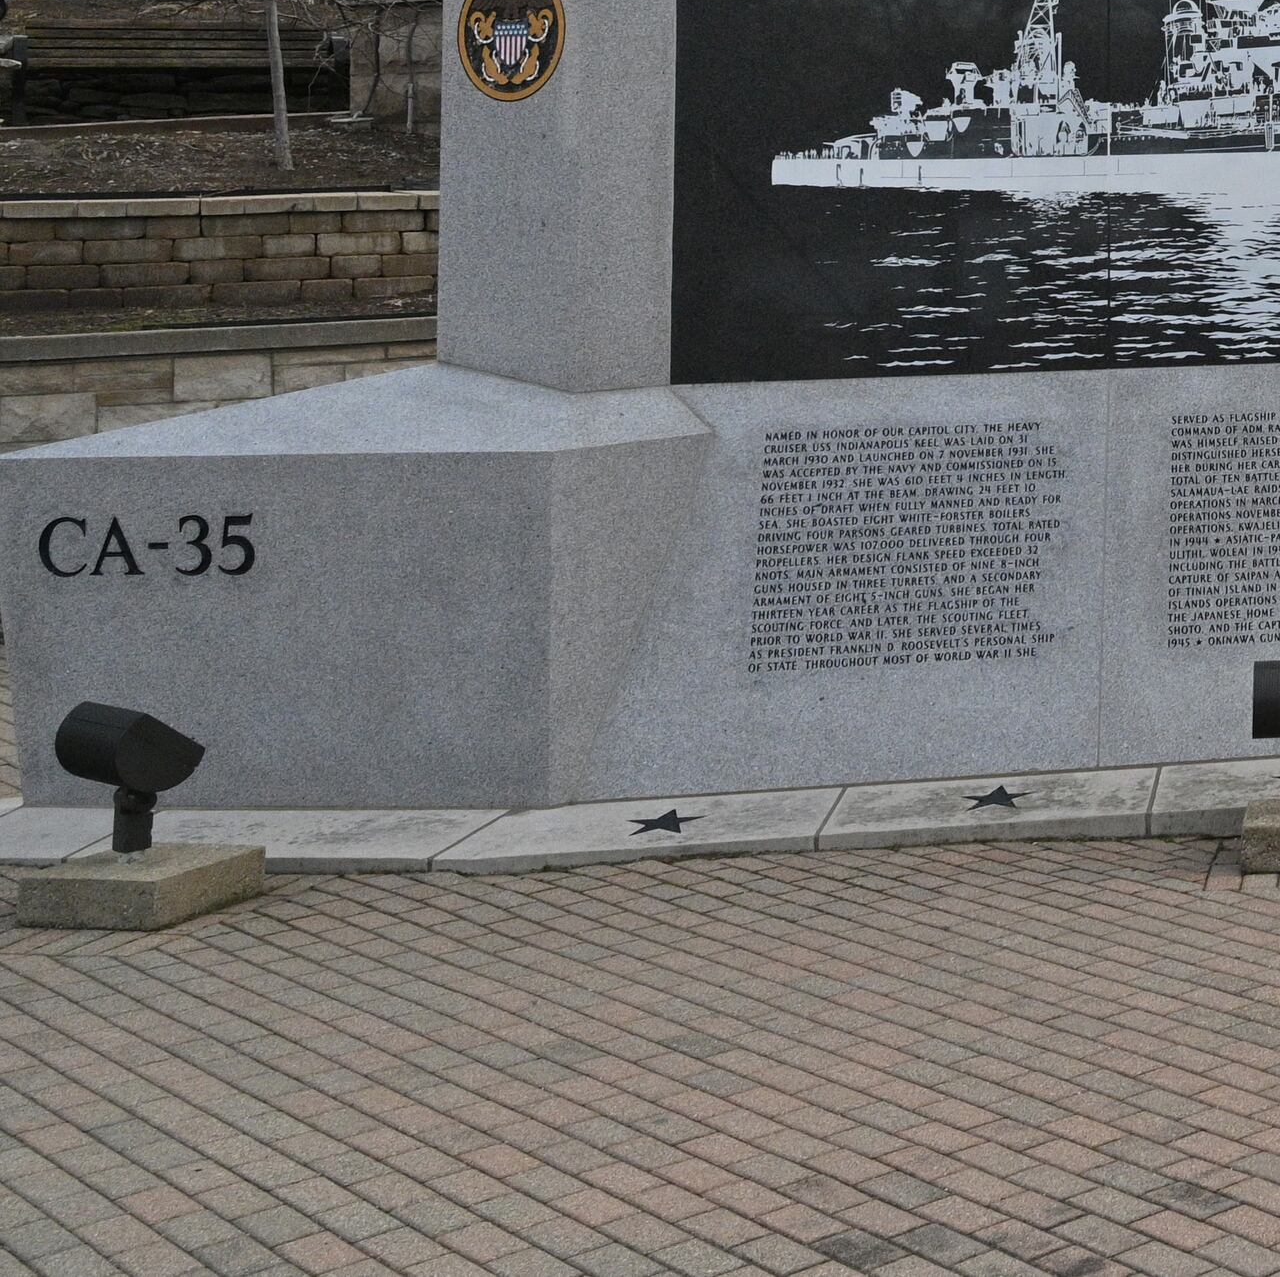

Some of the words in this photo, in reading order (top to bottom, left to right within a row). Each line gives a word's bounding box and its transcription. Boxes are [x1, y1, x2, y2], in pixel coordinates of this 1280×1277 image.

[1171, 414, 1208, 424] SERVED
[1229, 412, 1276, 422] FLAGSHIP
[765, 431, 801, 441] NAMED
[822, 429, 859, 439] HONOR
[908, 425, 949, 435] CAPITOL
[1007, 422, 1041, 431] HEAVY
[1171, 426, 1220, 436] COMMAND
[763, 443, 807, 453] CRUISER
[970, 436, 994, 445] LAID
[1197, 437, 1237, 447] HIMSELF
[1243, 436, 1278, 445] RAISED
[763, 456, 799, 466] MARCH
[859, 451, 914, 462] LAUNCHED
[949, 448, 1003, 458] NOVEMBER
[1171, 449, 1246, 460] DISTINGUISHED
[789, 467, 840, 477] ACCEPTED
[946, 459, 1023, 470] COMMISSIONED
[1195, 462, 1232, 471] DURING
[761, 480, 817, 491] NOVEMBER
[968, 472, 1005, 482] INCHES
[1245, 472, 1279, 482] BATTLE
[925, 486, 973, 496] DRAWING
[996, 484, 1019, 493] FEET
[759, 506, 797, 516] INCHES
[930, 498, 973, 508] MANNED
[1169, 498, 1230, 509] OPERATIONS
[812, 516, 858, 526] BOASTED
[989, 508, 1030, 518] BOILERS
[1169, 510, 1230, 521] OPERATIONS
[757, 531, 801, 542] DRIVING
[839, 527, 885, 538] PARSONS
[890, 525, 931, 535] GEARED
[1185, 536, 1208, 545] 1944
[38, 512, 256, 578] CA-35
[757, 542, 828, 555] HORSEPOWER
[909, 536, 964, 547] DELIVERED
[969, 533, 1019, 544] THROUGH
[852, 552, 890, 563] DESIGN
[970, 546, 1022, 557] EXCEEDED
[828, 565, 885, 577] ARMAMENT
[890, 562, 947, 574] CONSISTED
[1169, 560, 1223, 571] INCLUDING
[788, 581, 831, 592] HOUSED
[982, 570, 1041, 582] SECONDARY
[1168, 573, 1210, 583] CAPTURE
[753, 595, 811, 607] ARMAMENT
[1168, 598, 1210, 608] ISLANDS
[1215, 595, 1277, 606] OPERATIONS
[751, 608, 802, 620] THIRTEEN
[840, 604, 879, 615] CAREER
[928, 599, 978, 610] FLAGSHIP
[1193, 609, 1239, 620] JAPANESE
[751, 621, 804, 633] SCOUTING
[942, 611, 993, 622] SCOUTING
[917, 626, 956, 637] SERVED
[1011, 621, 1040, 632] TIMES
[767, 646, 824, 658] PRESIDENT
[830, 643, 881, 655] FRANKLIN
[974, 635, 1026, 646] PERSONAL
[1208, 634, 1255, 644] OKINAWA
[805, 656, 878, 669] THROUGHOUT
[933, 651, 971, 662] WORLD
